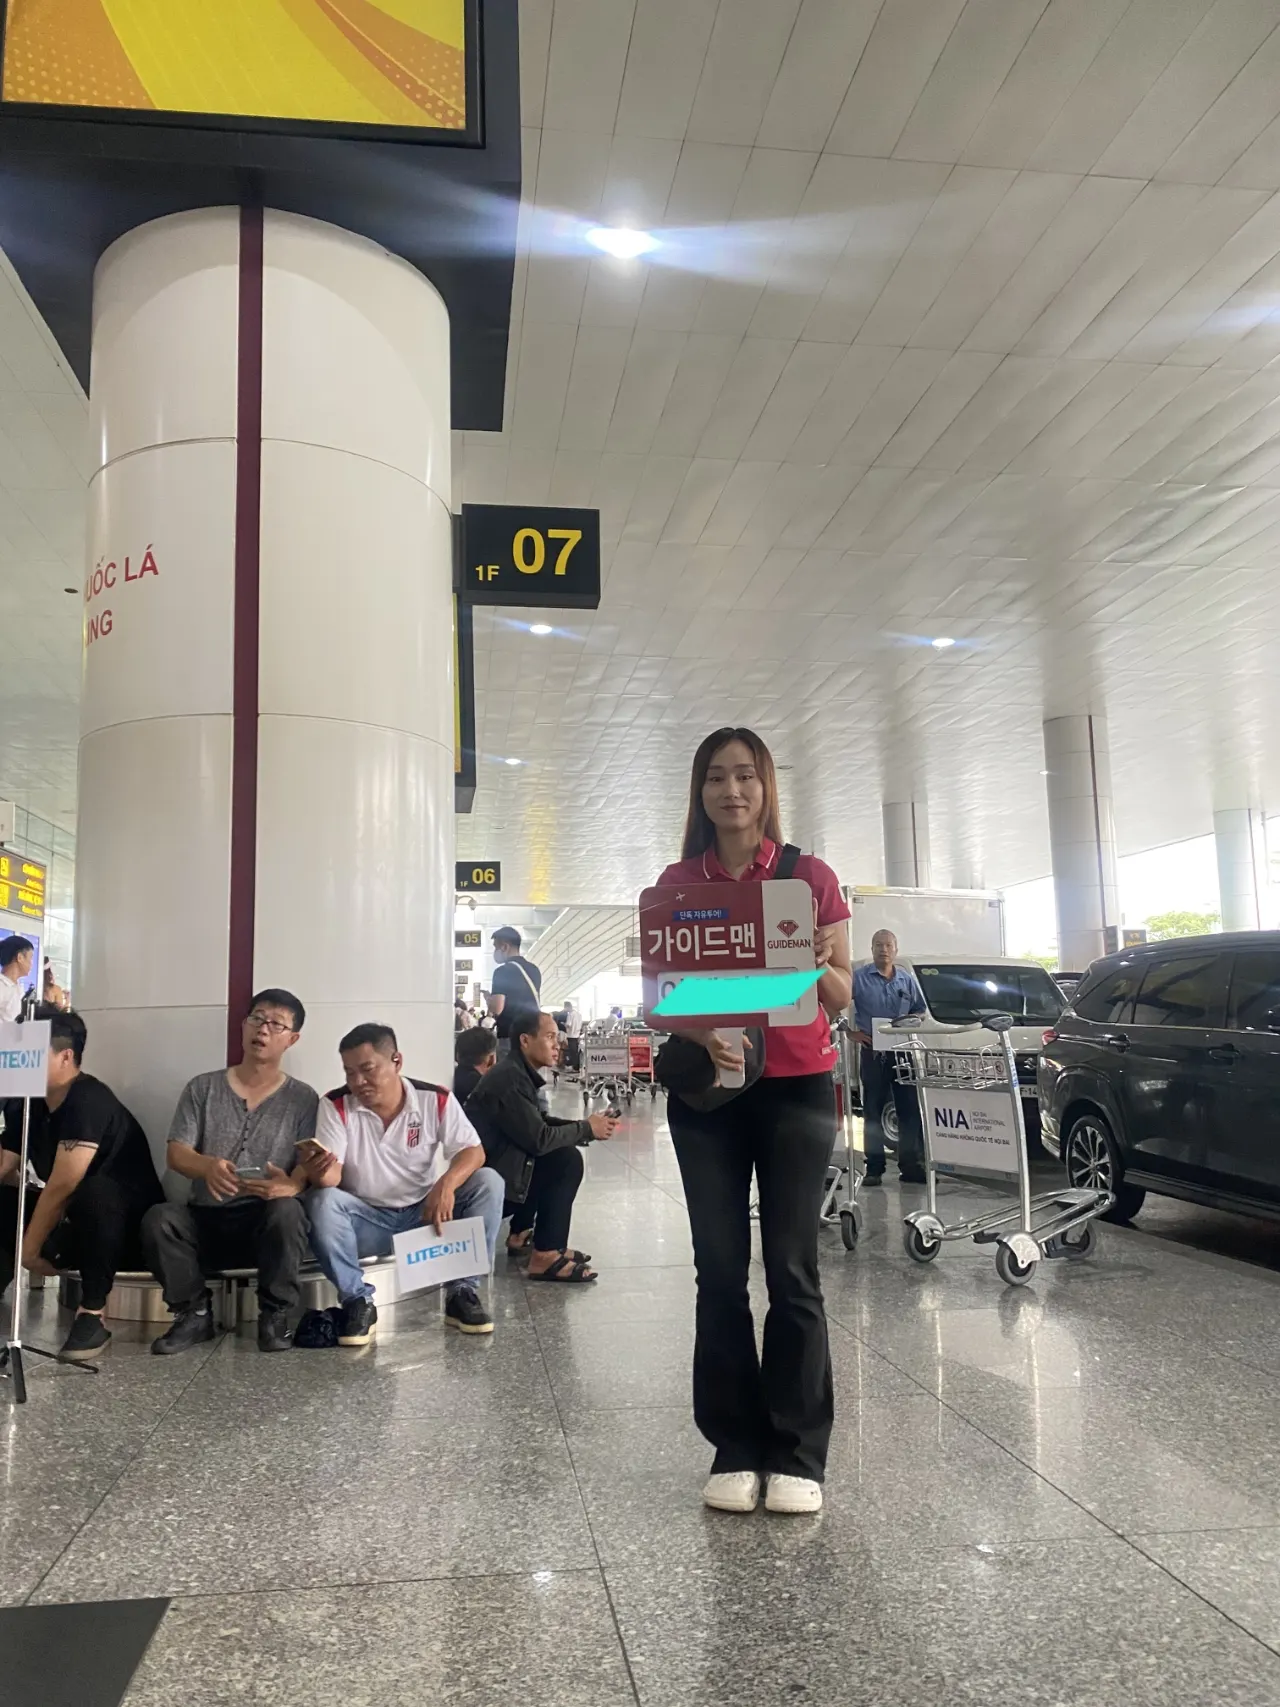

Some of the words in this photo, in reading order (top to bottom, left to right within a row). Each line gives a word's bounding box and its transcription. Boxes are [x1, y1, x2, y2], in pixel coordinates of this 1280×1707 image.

[124, 543, 159, 582] LÁ
[475, 565, 500, 581] 1F
[511, 527, 583, 577] 07
[472, 868, 496, 885] 06
[464, 933, 478, 943] 05
[648, 922, 757, 962] 가이드맨
[767, 939, 811, 949] GUIDEMAN
[934, 1107, 970, 1130] NIA
[406, 1240, 468, 1265] LITEON
